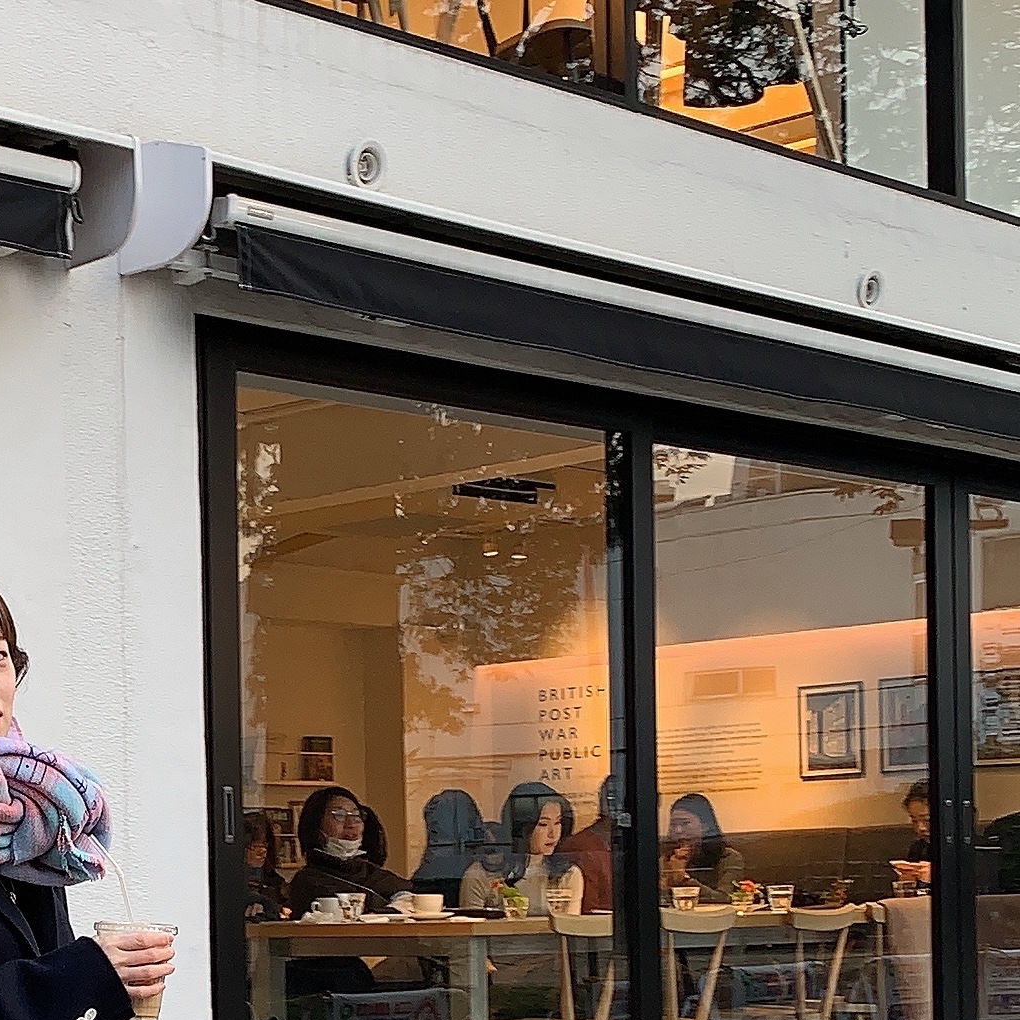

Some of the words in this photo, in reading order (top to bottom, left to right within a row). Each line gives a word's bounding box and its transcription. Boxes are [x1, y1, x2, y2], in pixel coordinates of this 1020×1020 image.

[538, 706, 582, 721] POST
[538, 727, 578, 742] WAR
[537, 745, 602, 762] PUBLIC
[539, 767, 573, 782] ART
